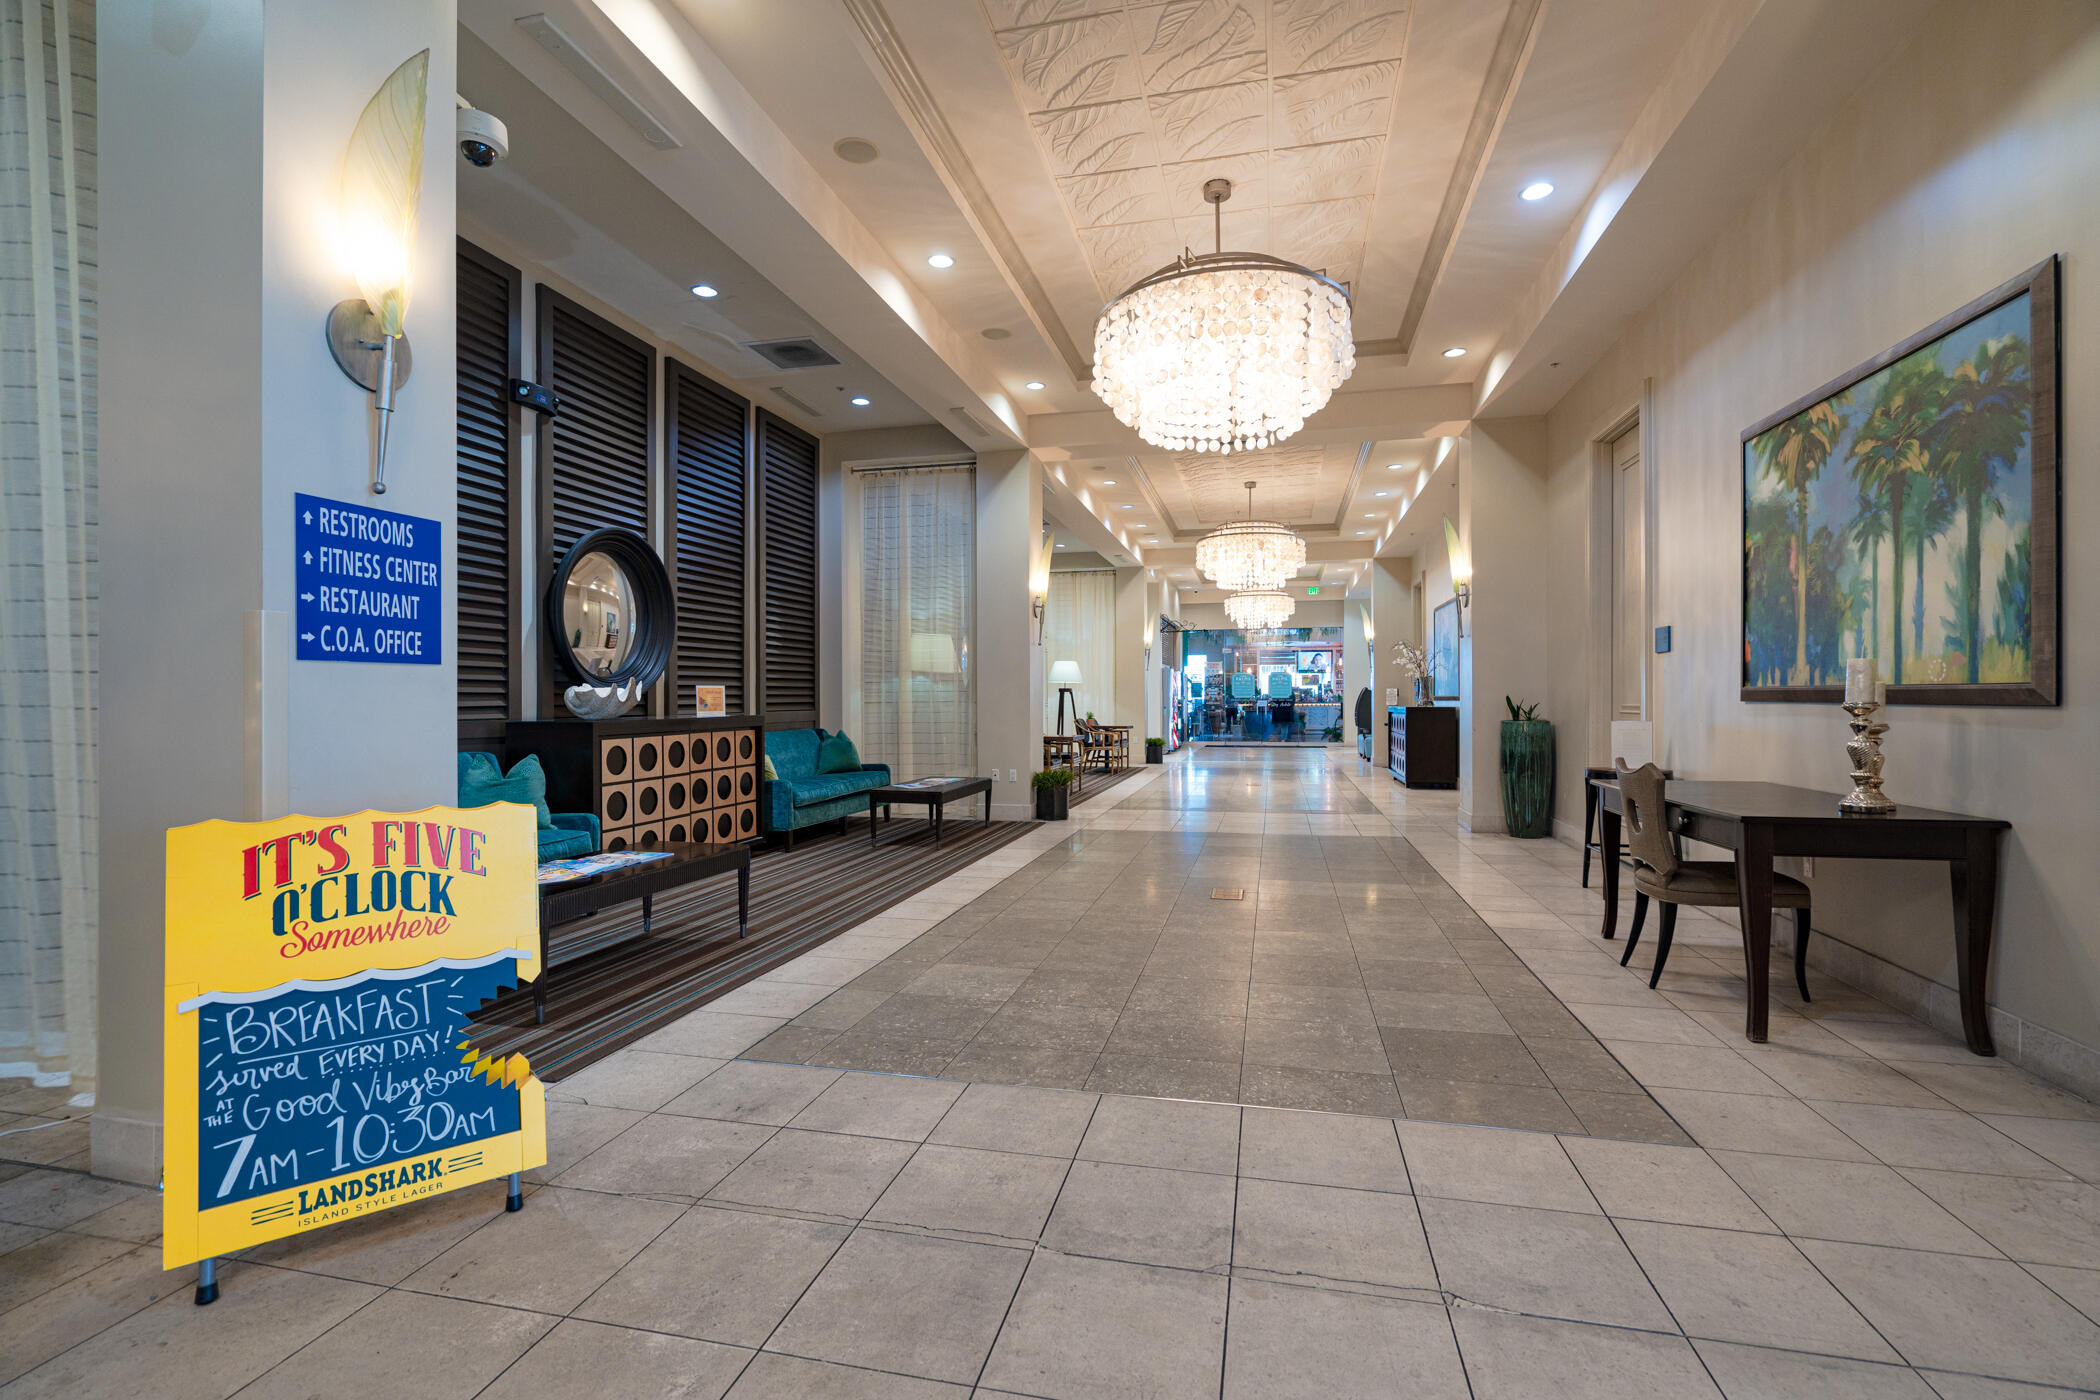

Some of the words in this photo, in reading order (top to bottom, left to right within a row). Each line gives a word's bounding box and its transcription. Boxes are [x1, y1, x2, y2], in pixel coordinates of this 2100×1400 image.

[319, 506, 414, 548] RESTROOMS
[319, 546, 381, 580] FITNESS
[385, 556, 438, 587] CENTER
[319, 585, 420, 620] RESTAURANT
[320, 624, 369, 653] C.O.A.
[374, 628, 422, 656] OFFICE
[241, 824, 350, 900] IT'S
[371, 820, 487, 877] FIVE
[271, 870, 458, 937] O'CLOCK
[279, 909, 451, 959] Somewhere
[225, 979, 446, 1055] BREAKFAST
[205, 1056, 309, 1096] served
[319, 1043, 385, 1076] EVERY
[393, 1025, 453, 1060] DAY!
[203, 1110, 234, 1128] THE
[215, 1097, 235, 1113] AT
[242, 1078, 348, 1132] Good
[423, 1066, 475, 1097] Bar
[297, 1157, 444, 1216] LANDSHARK
[298, 1207, 349, 1228] ISLAND
[355, 1194, 397, 1212] STYLE
[402, 1181, 443, 1199] LAGER
